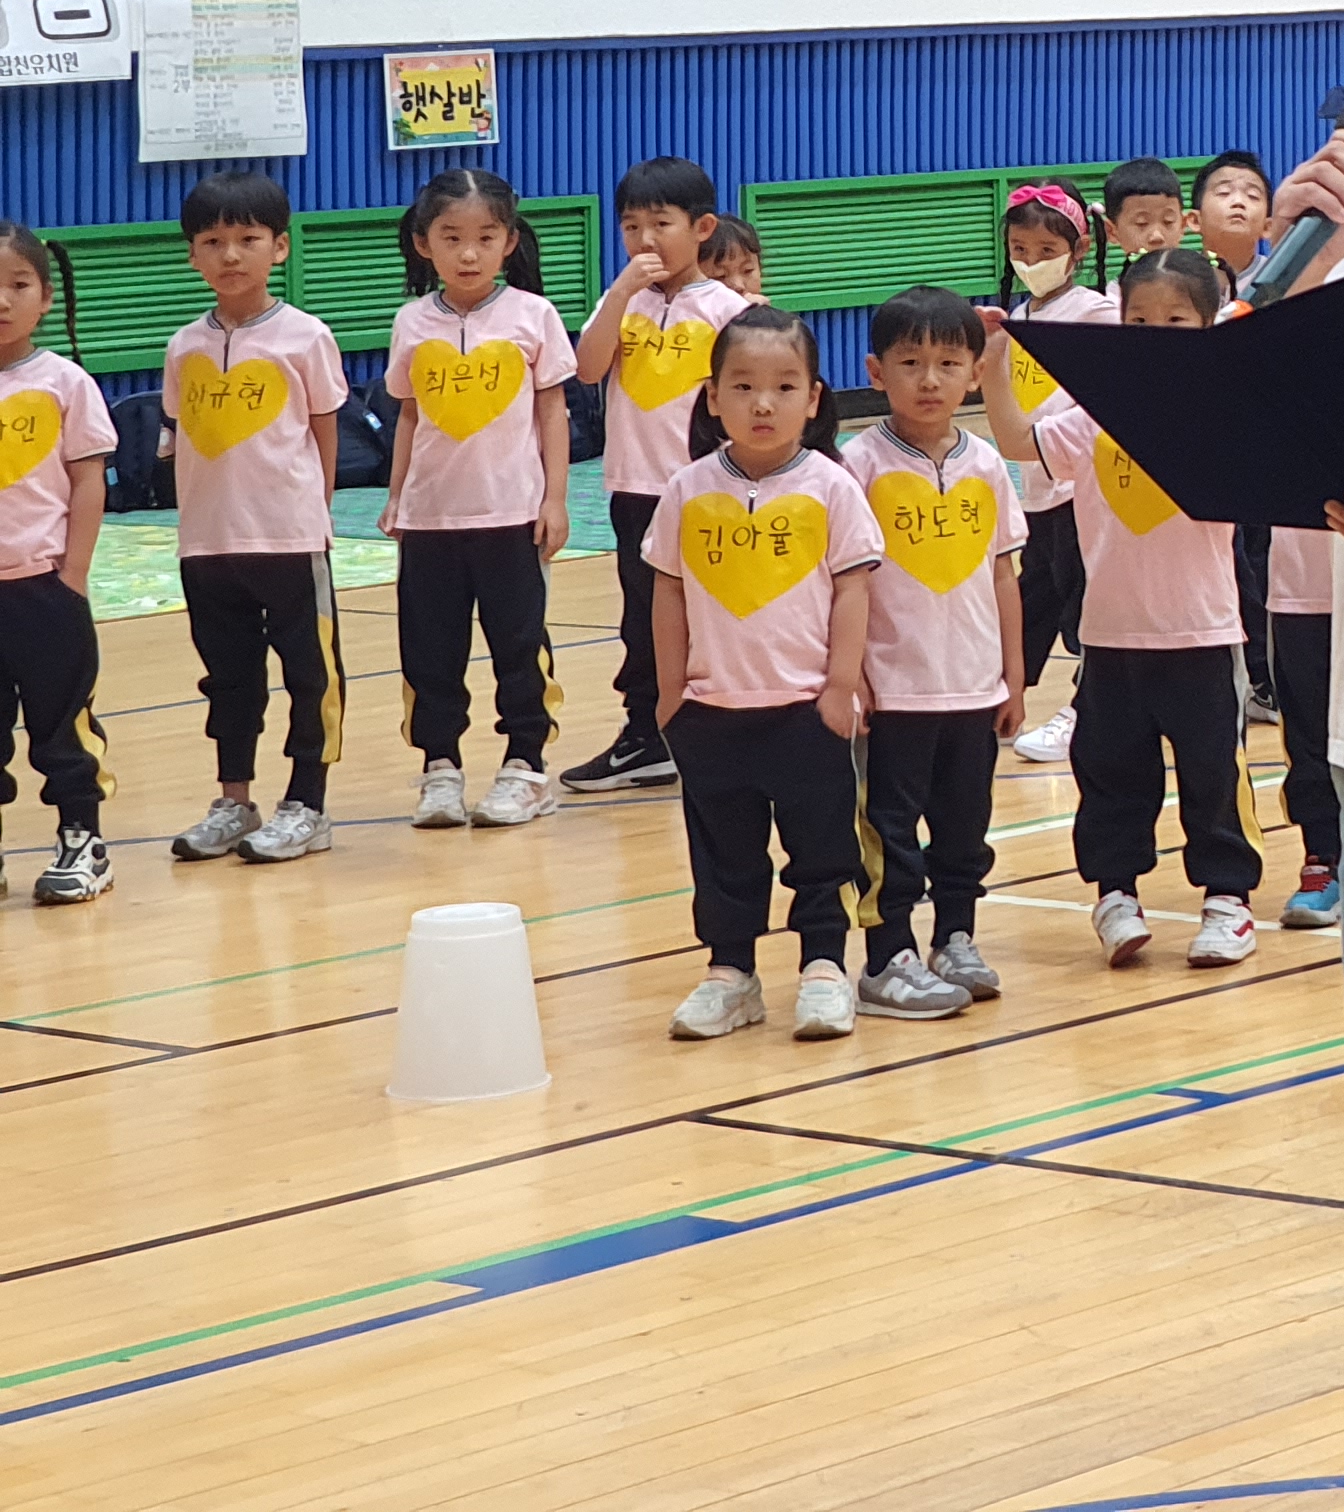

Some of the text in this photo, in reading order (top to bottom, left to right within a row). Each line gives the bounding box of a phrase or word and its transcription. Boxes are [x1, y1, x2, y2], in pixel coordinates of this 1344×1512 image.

[399, 79, 487, 123] 햇살반
[426, 362, 500, 395] 최은성
[699, 515, 793, 565] 김아율
[894, 499, 981, 546] 한도현
